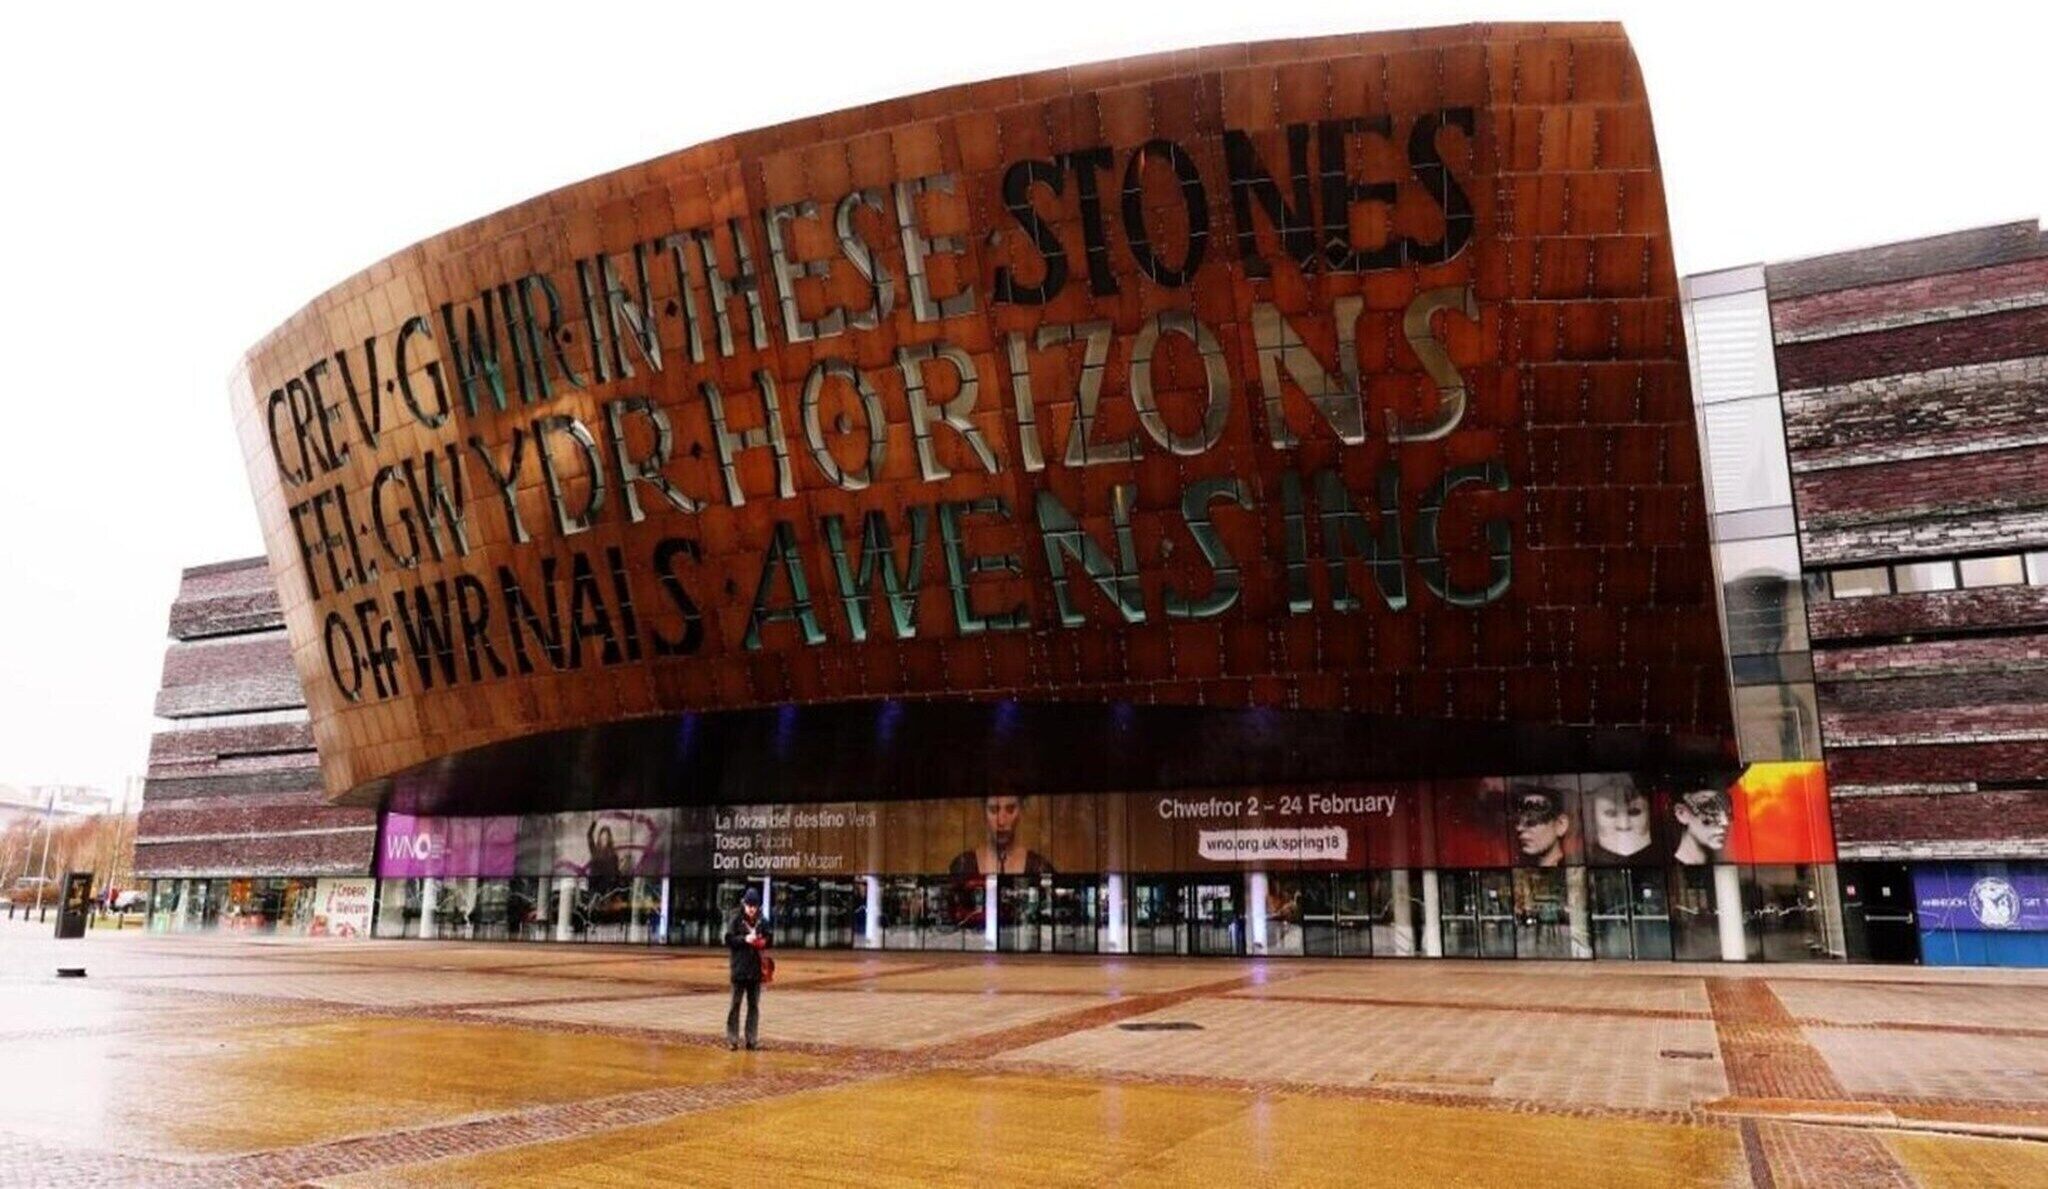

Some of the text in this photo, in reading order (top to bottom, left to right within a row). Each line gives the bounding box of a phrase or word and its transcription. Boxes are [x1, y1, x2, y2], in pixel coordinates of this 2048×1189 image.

[395, 273, 588, 430] GWIR
[655, 173, 976, 364] THESE
[995, 108, 1475, 306] STONES
[289, 484, 378, 600] FEL
[700, 287, 1480, 507] HORIZONS
[744, 483, 1146, 651] AWEN
[1163, 462, 1512, 620] SING
[1158, 796, 1242, 818] Chwefror
[1247, 796, 1259, 816] 2
[1279, 796, 1303, 815] 24
[1308, 793, 1397, 817] February
[715, 810, 877, 830] La forza del destino Verdi
[714, 833, 793, 850] Tosca Puccini
[1206, 835, 1340, 853] wno.org.uk/spring18
[713, 851, 843, 870] Don Giovanni Mozart
